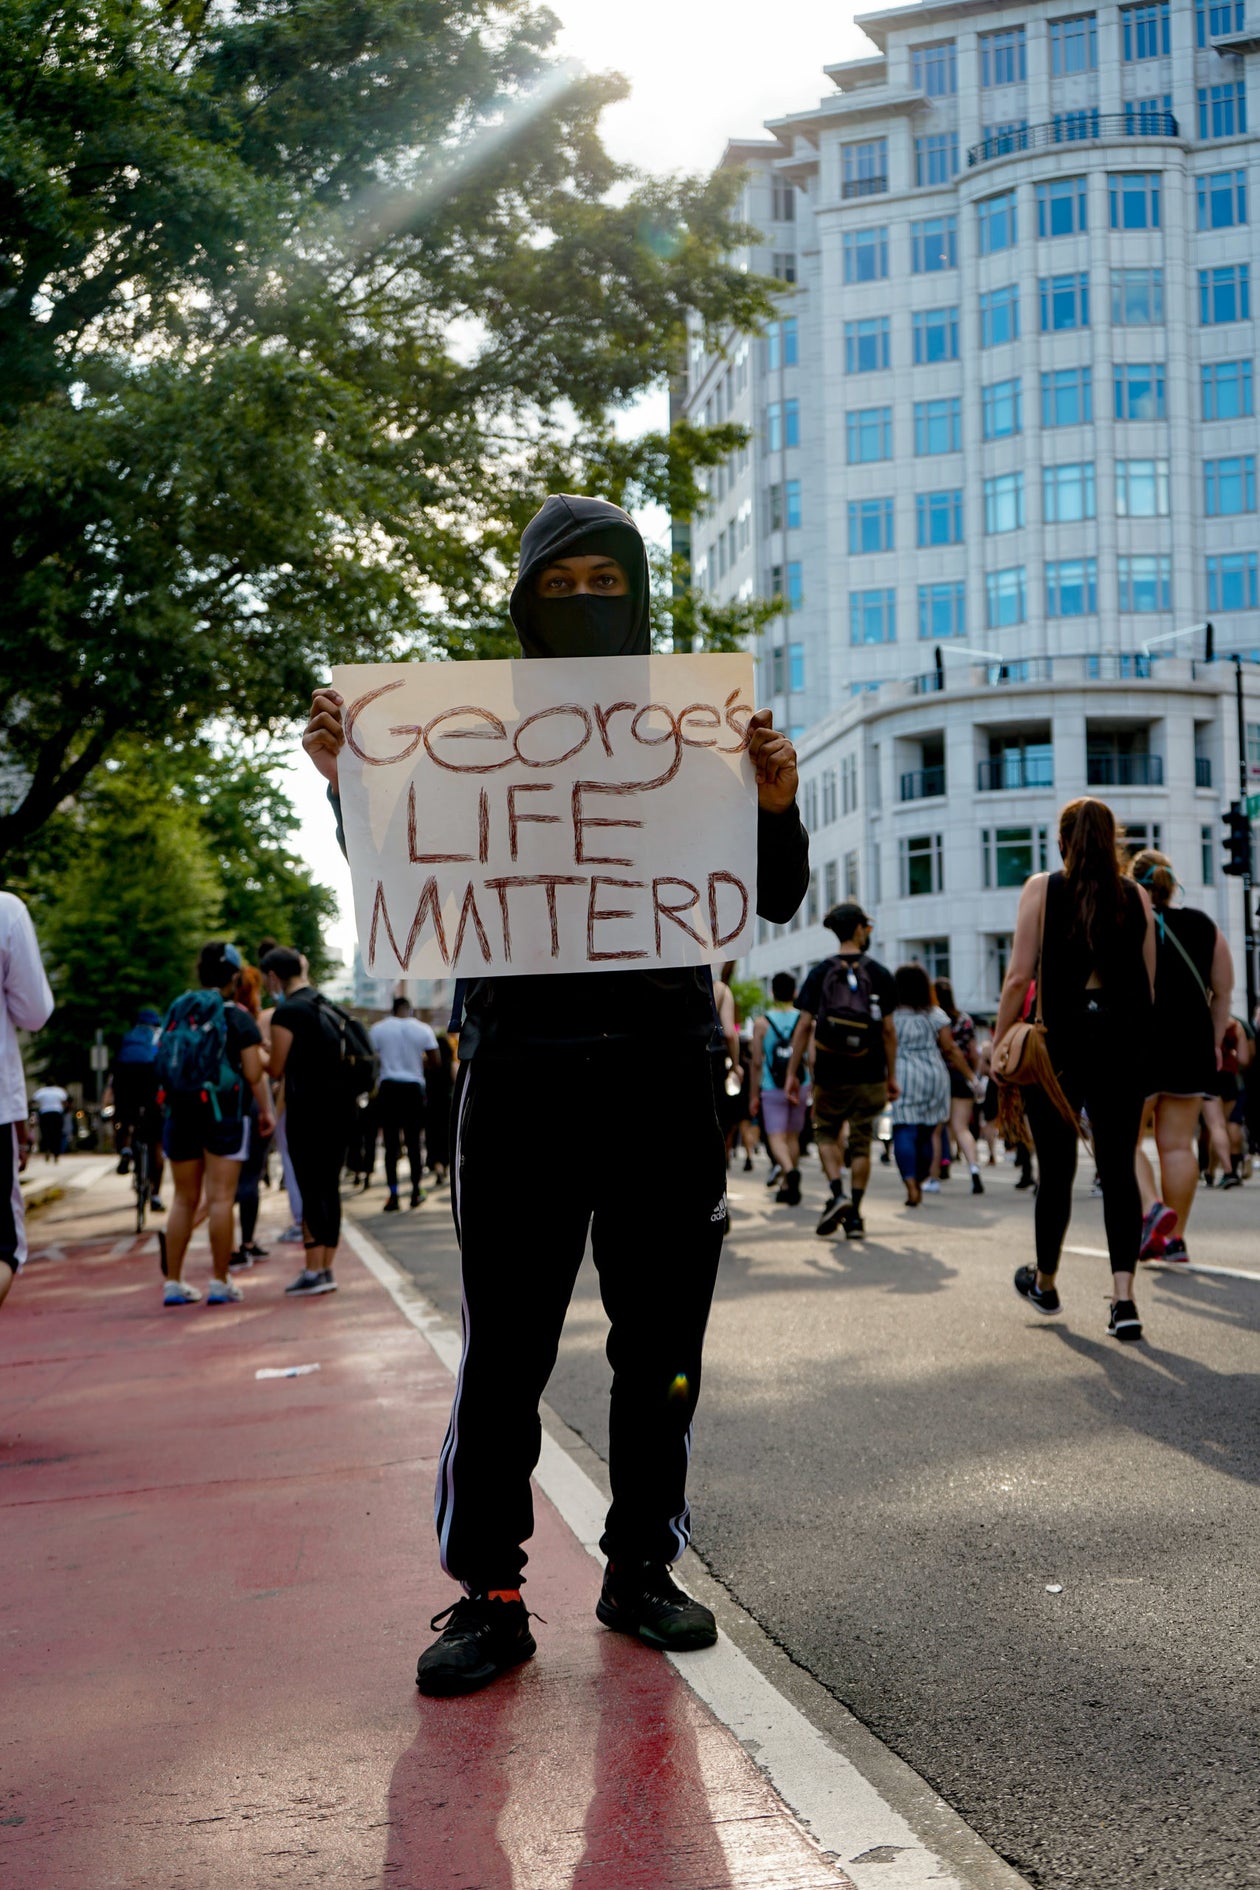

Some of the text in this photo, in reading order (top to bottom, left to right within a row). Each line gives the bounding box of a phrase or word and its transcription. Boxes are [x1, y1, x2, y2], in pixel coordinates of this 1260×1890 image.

[344, 679, 752, 790] George's
[406, 780, 646, 866] LIFE
[369, 870, 749, 971] MATTERD
